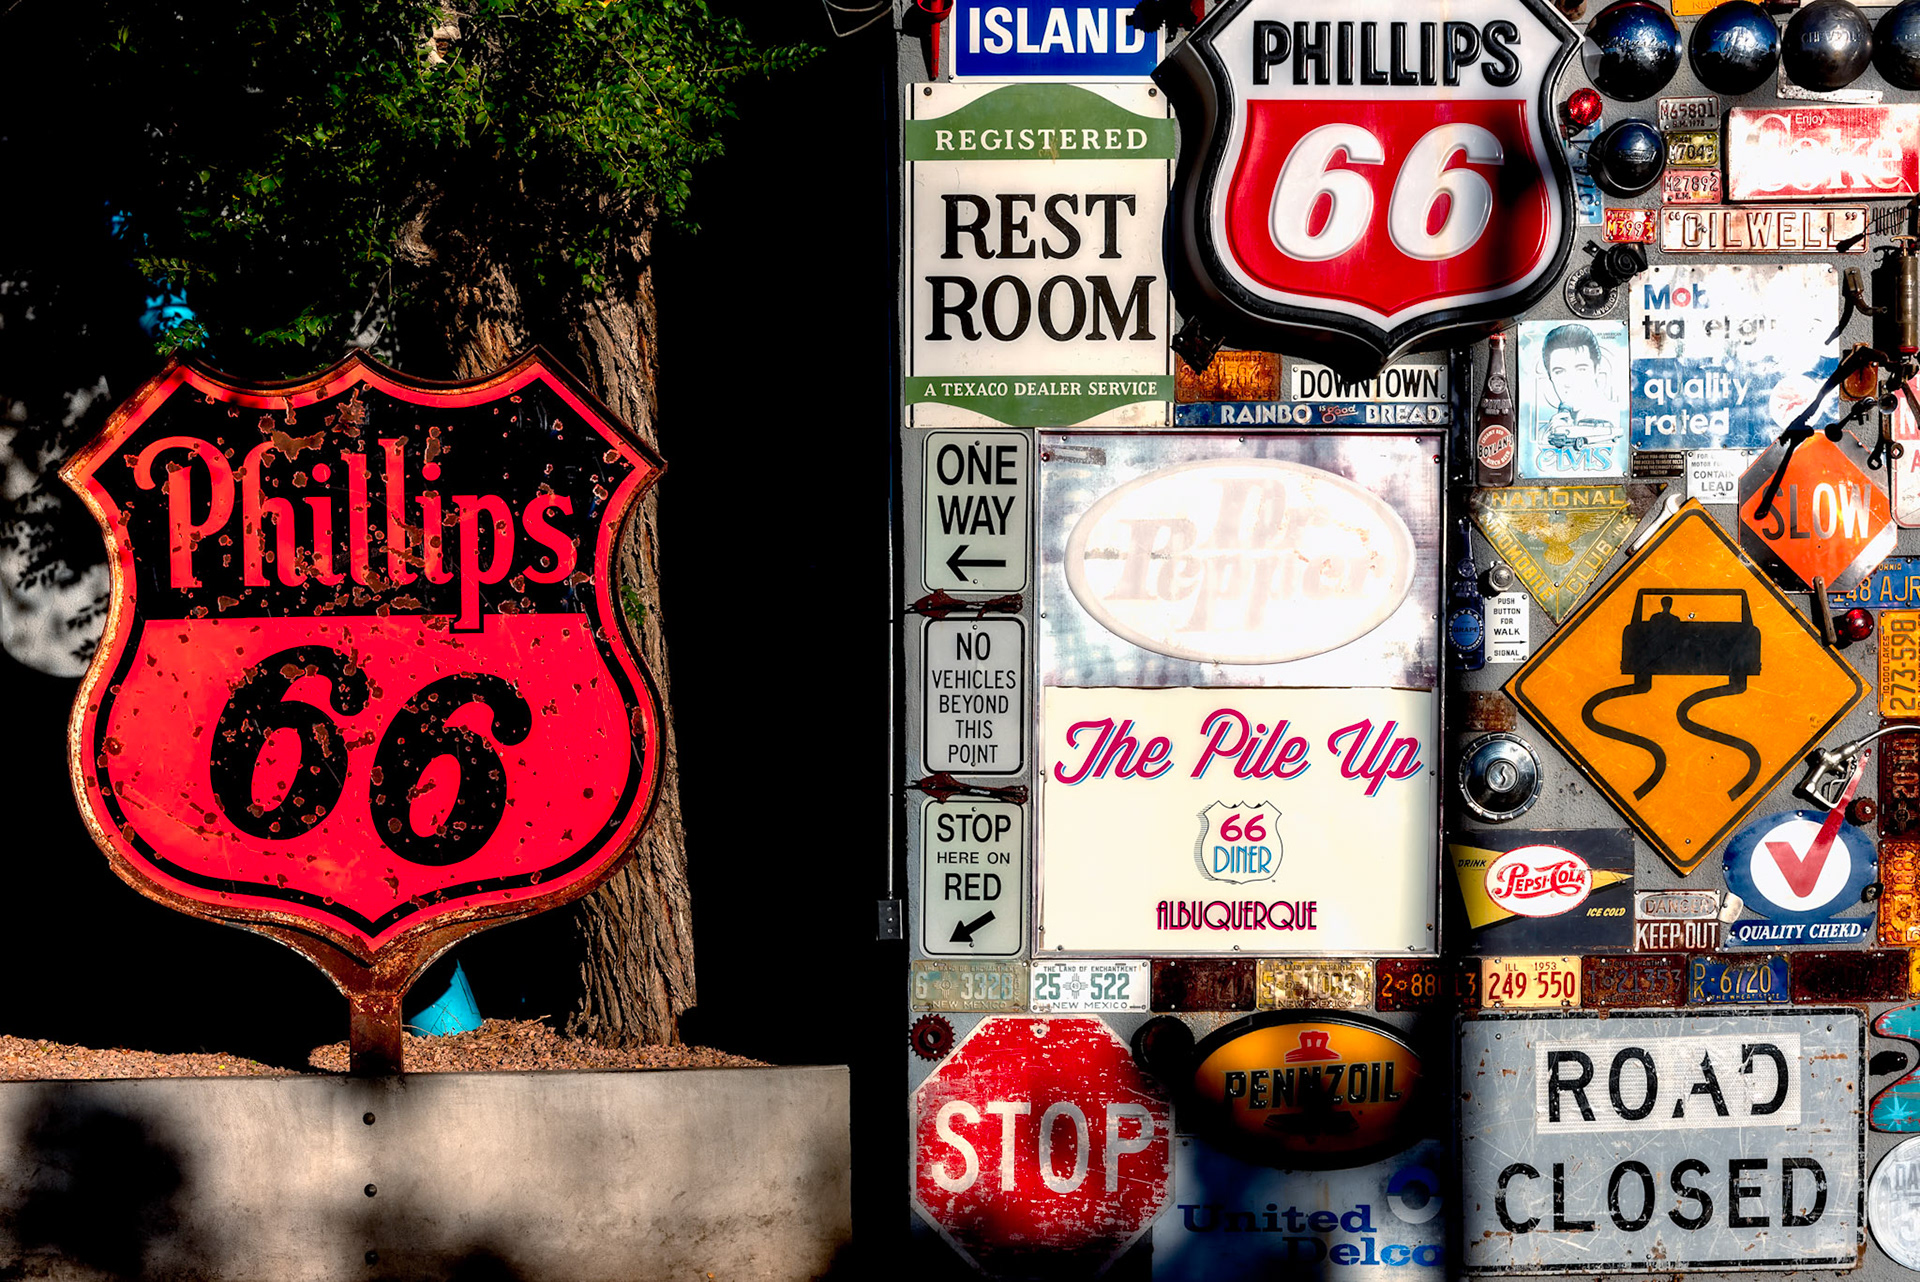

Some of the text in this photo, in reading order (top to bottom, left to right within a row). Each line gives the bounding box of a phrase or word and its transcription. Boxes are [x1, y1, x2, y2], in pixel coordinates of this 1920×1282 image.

[968, 7, 1145, 54] ISLAND
[1253, 20, 1522, 86] PHILLIPS
[1660, 103, 1715, 120] M65801
[1795, 113, 1825, 125] Enjoy
[935, 128, 1148, 151] REGISTERED
[1746, 114, 1904, 192] Coke
[1268, 122, 1505, 262] 66
[1663, 175, 1718, 192] M27892
[940, 193, 1137, 260] REST
[1606, 220, 1653, 237] M3993
[925, 275, 1157, 341] ROOM
[1592, 292, 1617, 316] COMPANY
[1644, 283, 1710, 310] Mob
[1642, 315, 1730, 340] trael
[924, 381, 1158, 397] A TEXACO DEALER SERVICE
[1643, 372, 1751, 406] quality
[1220, 405, 1313, 425] RAINBO
[1321, 404, 1357, 424] good
[1365, 404, 1442, 424] BREAD
[1645, 407, 1731, 436] rated
[1478, 433, 1514, 458] BOYLAN'S
[936, 445, 1018, 486] ONE
[1693, 470, 1735, 479] CONTAIN
[1491, 490, 1626, 507] NATIONAL
[1701, 481, 1734, 491] LEAD
[937, 495, 1016, 536] WAY
[1762, 482, 1872, 541] SLOW
[134, 435, 578, 631] Phillips
[1480, 514, 1558, 602] AUTOMOBILE
[1565, 539, 1613, 594] CLUB
[1104, 517, 1385, 633] Pepper
[956, 631, 991, 661] NO
[932, 669, 1017, 689] VEHICLES
[1882, 635, 1890, 694] 10,000 LAKES
[1890, 619, 1917, 710] 273-598
[939, 694, 1009, 714] BEYOND
[955, 719, 993, 739] THIS
[210, 645, 532, 866] 66
[947, 743, 998, 764] POINT
[1053, 708, 1425, 797] The Pile Up
[936, 813, 1012, 844] STOP
[1220, 813, 1267, 843] 66
[936, 851, 1011, 865] HERE ON
[1213, 845, 1273, 875] DINER
[1457, 859, 1487, 868] DRINK
[944, 873, 1002, 901] RED
[1156, 900, 1318, 931] ALBUQUERQUE
[1586, 907, 1626, 917] ICE COLD
[1645, 899, 1710, 914] DANGER
[1636, 922, 1719, 949] KEEP OUT
[1739, 922, 1861, 941] QUALITY CHEKD
[1505, 961, 1557, 972] ILL 1953
[1719, 964, 1771, 993] 6720
[961, 971, 1013, 1000] 3328
[1034, 972, 1130, 1000] 25 522
[1488, 972, 1527, 999] 249
[1537, 971, 1576, 999] 550
[932, 1000, 1007, 1009] NEW MEXICO
[1084, 1001, 1128, 1009] MEXICO
[1278, 1000, 1353, 1009] NEW MEXICO
[1222, 1062, 1402, 1110] PENNZOIL
[1547, 1042, 1789, 1123] ROAD
[931, 1100, 1156, 1194] STOP
[1494, 1156, 1828, 1235] CLOSED
[1177, 1203, 1378, 1233] United
[1282, 1236, 1445, 1267] Delco
